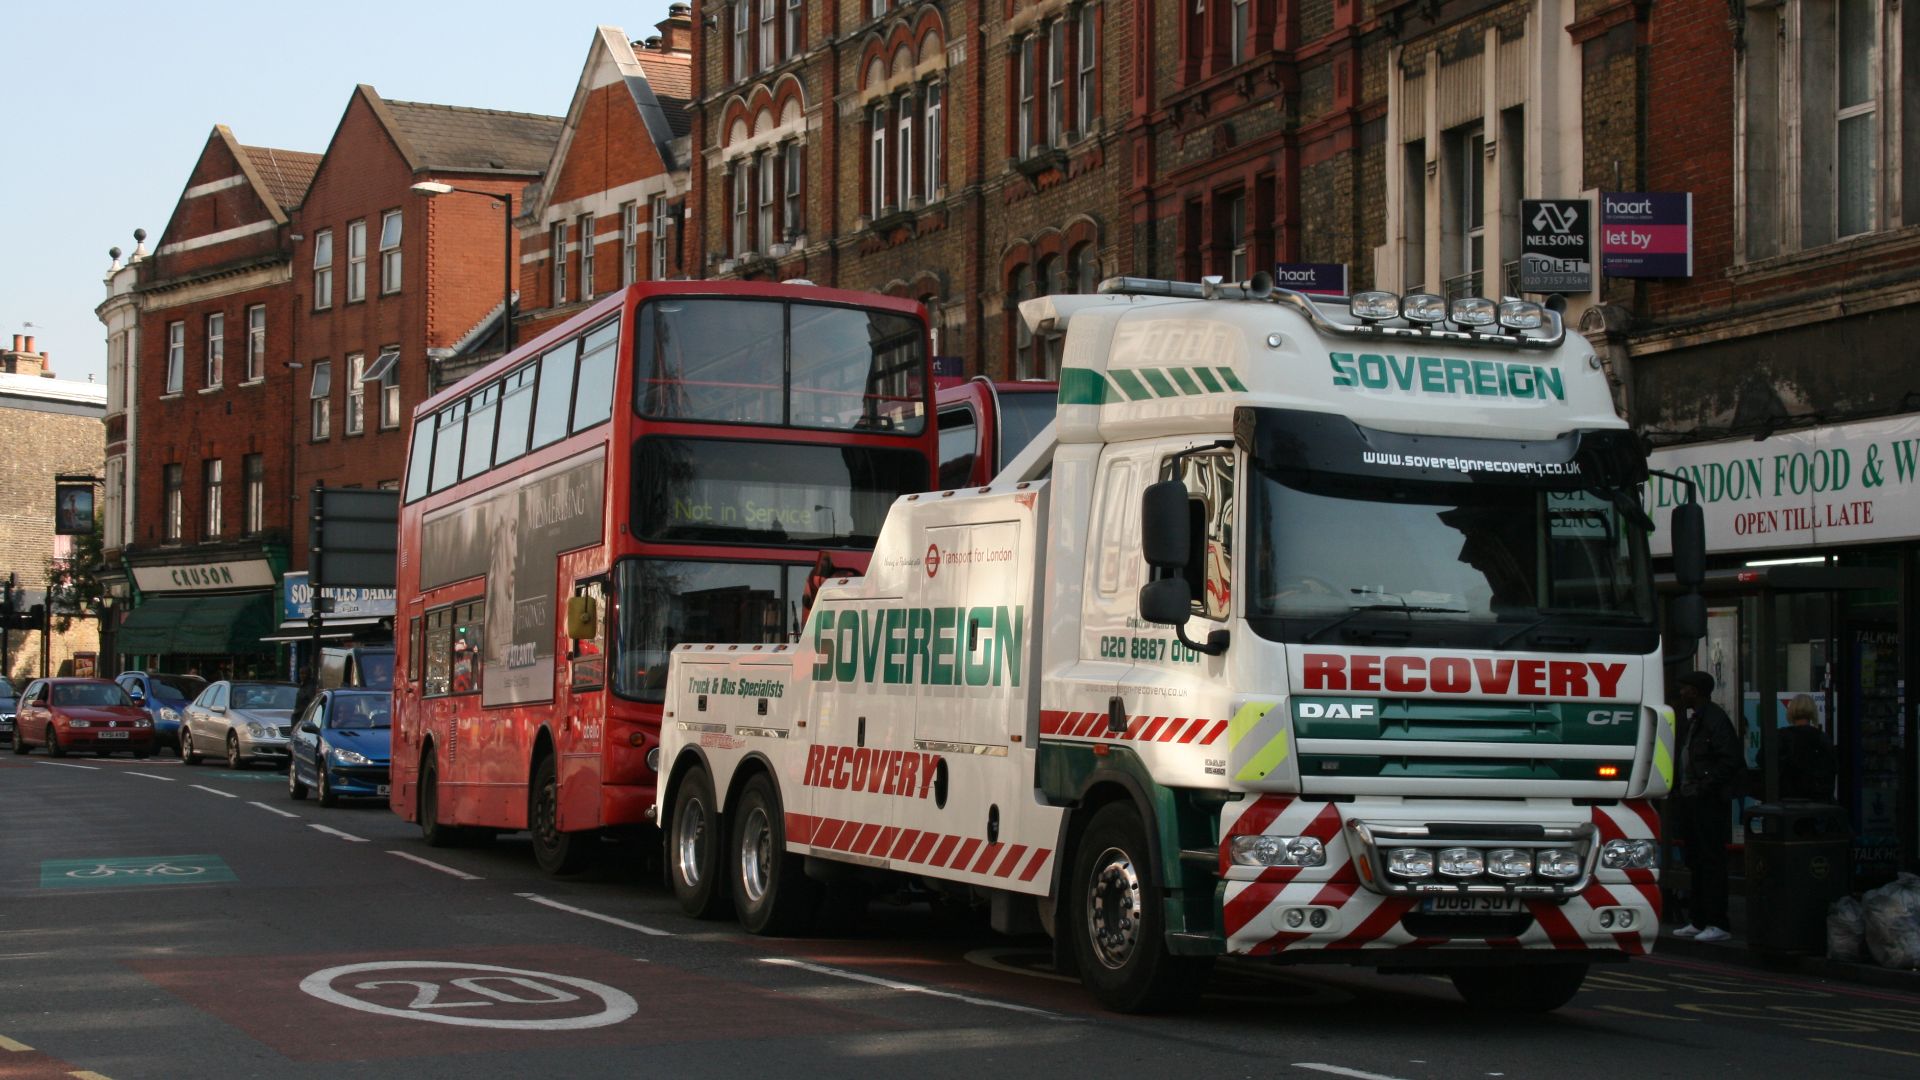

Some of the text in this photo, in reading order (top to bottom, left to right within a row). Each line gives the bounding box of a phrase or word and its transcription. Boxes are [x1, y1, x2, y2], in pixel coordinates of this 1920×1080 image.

[1606, 197, 1652, 214] haart
[1526, 234, 1584, 246] NELSONS
[1606, 230, 1652, 249] let by
[1279, 266, 1316, 281] haart
[1529, 259, 1582, 273] TO LET
[1524, 276, 1541, 285] 020
[1329, 352, 1565, 401] SOVEREIGN
[1362, 450, 1582, 480] www.sovereignrecovery.co.uk
[1656, 456, 1765, 509] LONDON
[1773, 448, 1851, 497] FOOD
[1861, 443, 1885, 489] &
[674, 500, 813, 525] Not in Service
[1734, 501, 1875, 536] OPEN TILL LATE
[942, 548, 972, 564] Transport
[974, 548, 984, 562] for
[986, 547, 1013, 561] London
[171, 566, 234, 588] CRUSON
[812, 605, 1025, 688] SOVEREIGN
[1101, 636, 1126, 658] 020
[1131, 638, 1167, 661] 8887
[1856, 630, 1884, 644] TALK
[1303, 653, 1628, 698] RECOVERY
[688, 677, 785, 699] Truck & Bus Specialists
[1299, 702, 1634, 726] DAF CF
[803, 744, 942, 799] RECOVERY
[354, 976, 581, 1009] 20
